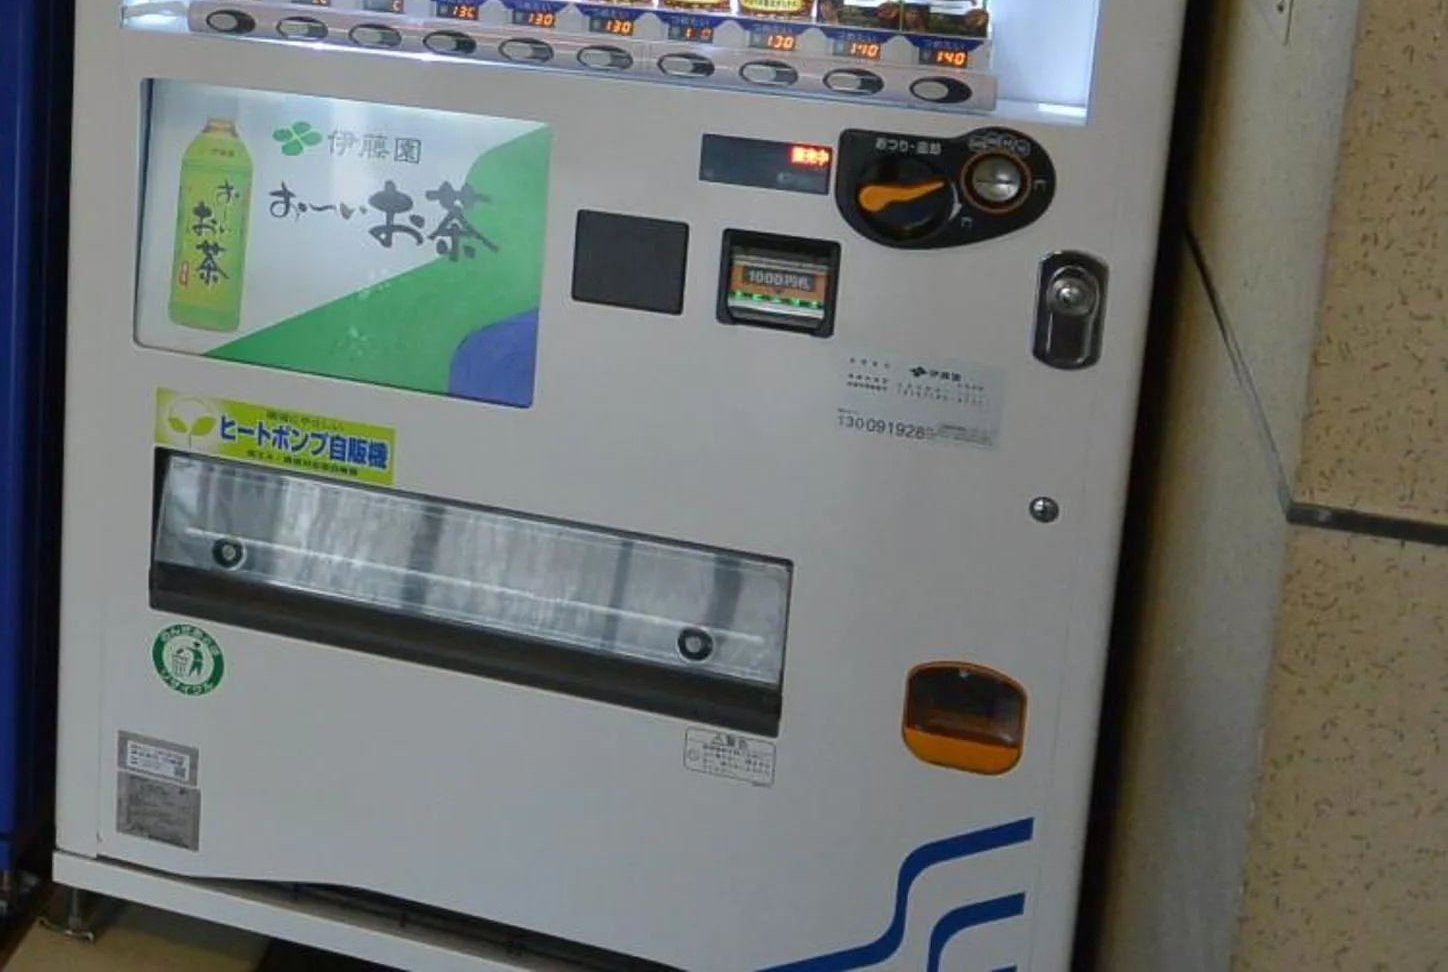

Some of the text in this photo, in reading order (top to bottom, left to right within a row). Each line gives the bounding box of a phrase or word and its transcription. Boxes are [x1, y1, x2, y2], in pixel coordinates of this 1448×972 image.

[528, 12, 553, 27] 130
[604, 19, 632, 34] 130
[936, 50, 967, 66] 140
[327, 128, 422, 165] 伊藤園
[219, 414, 390, 471] ヒートポンプ自販機
